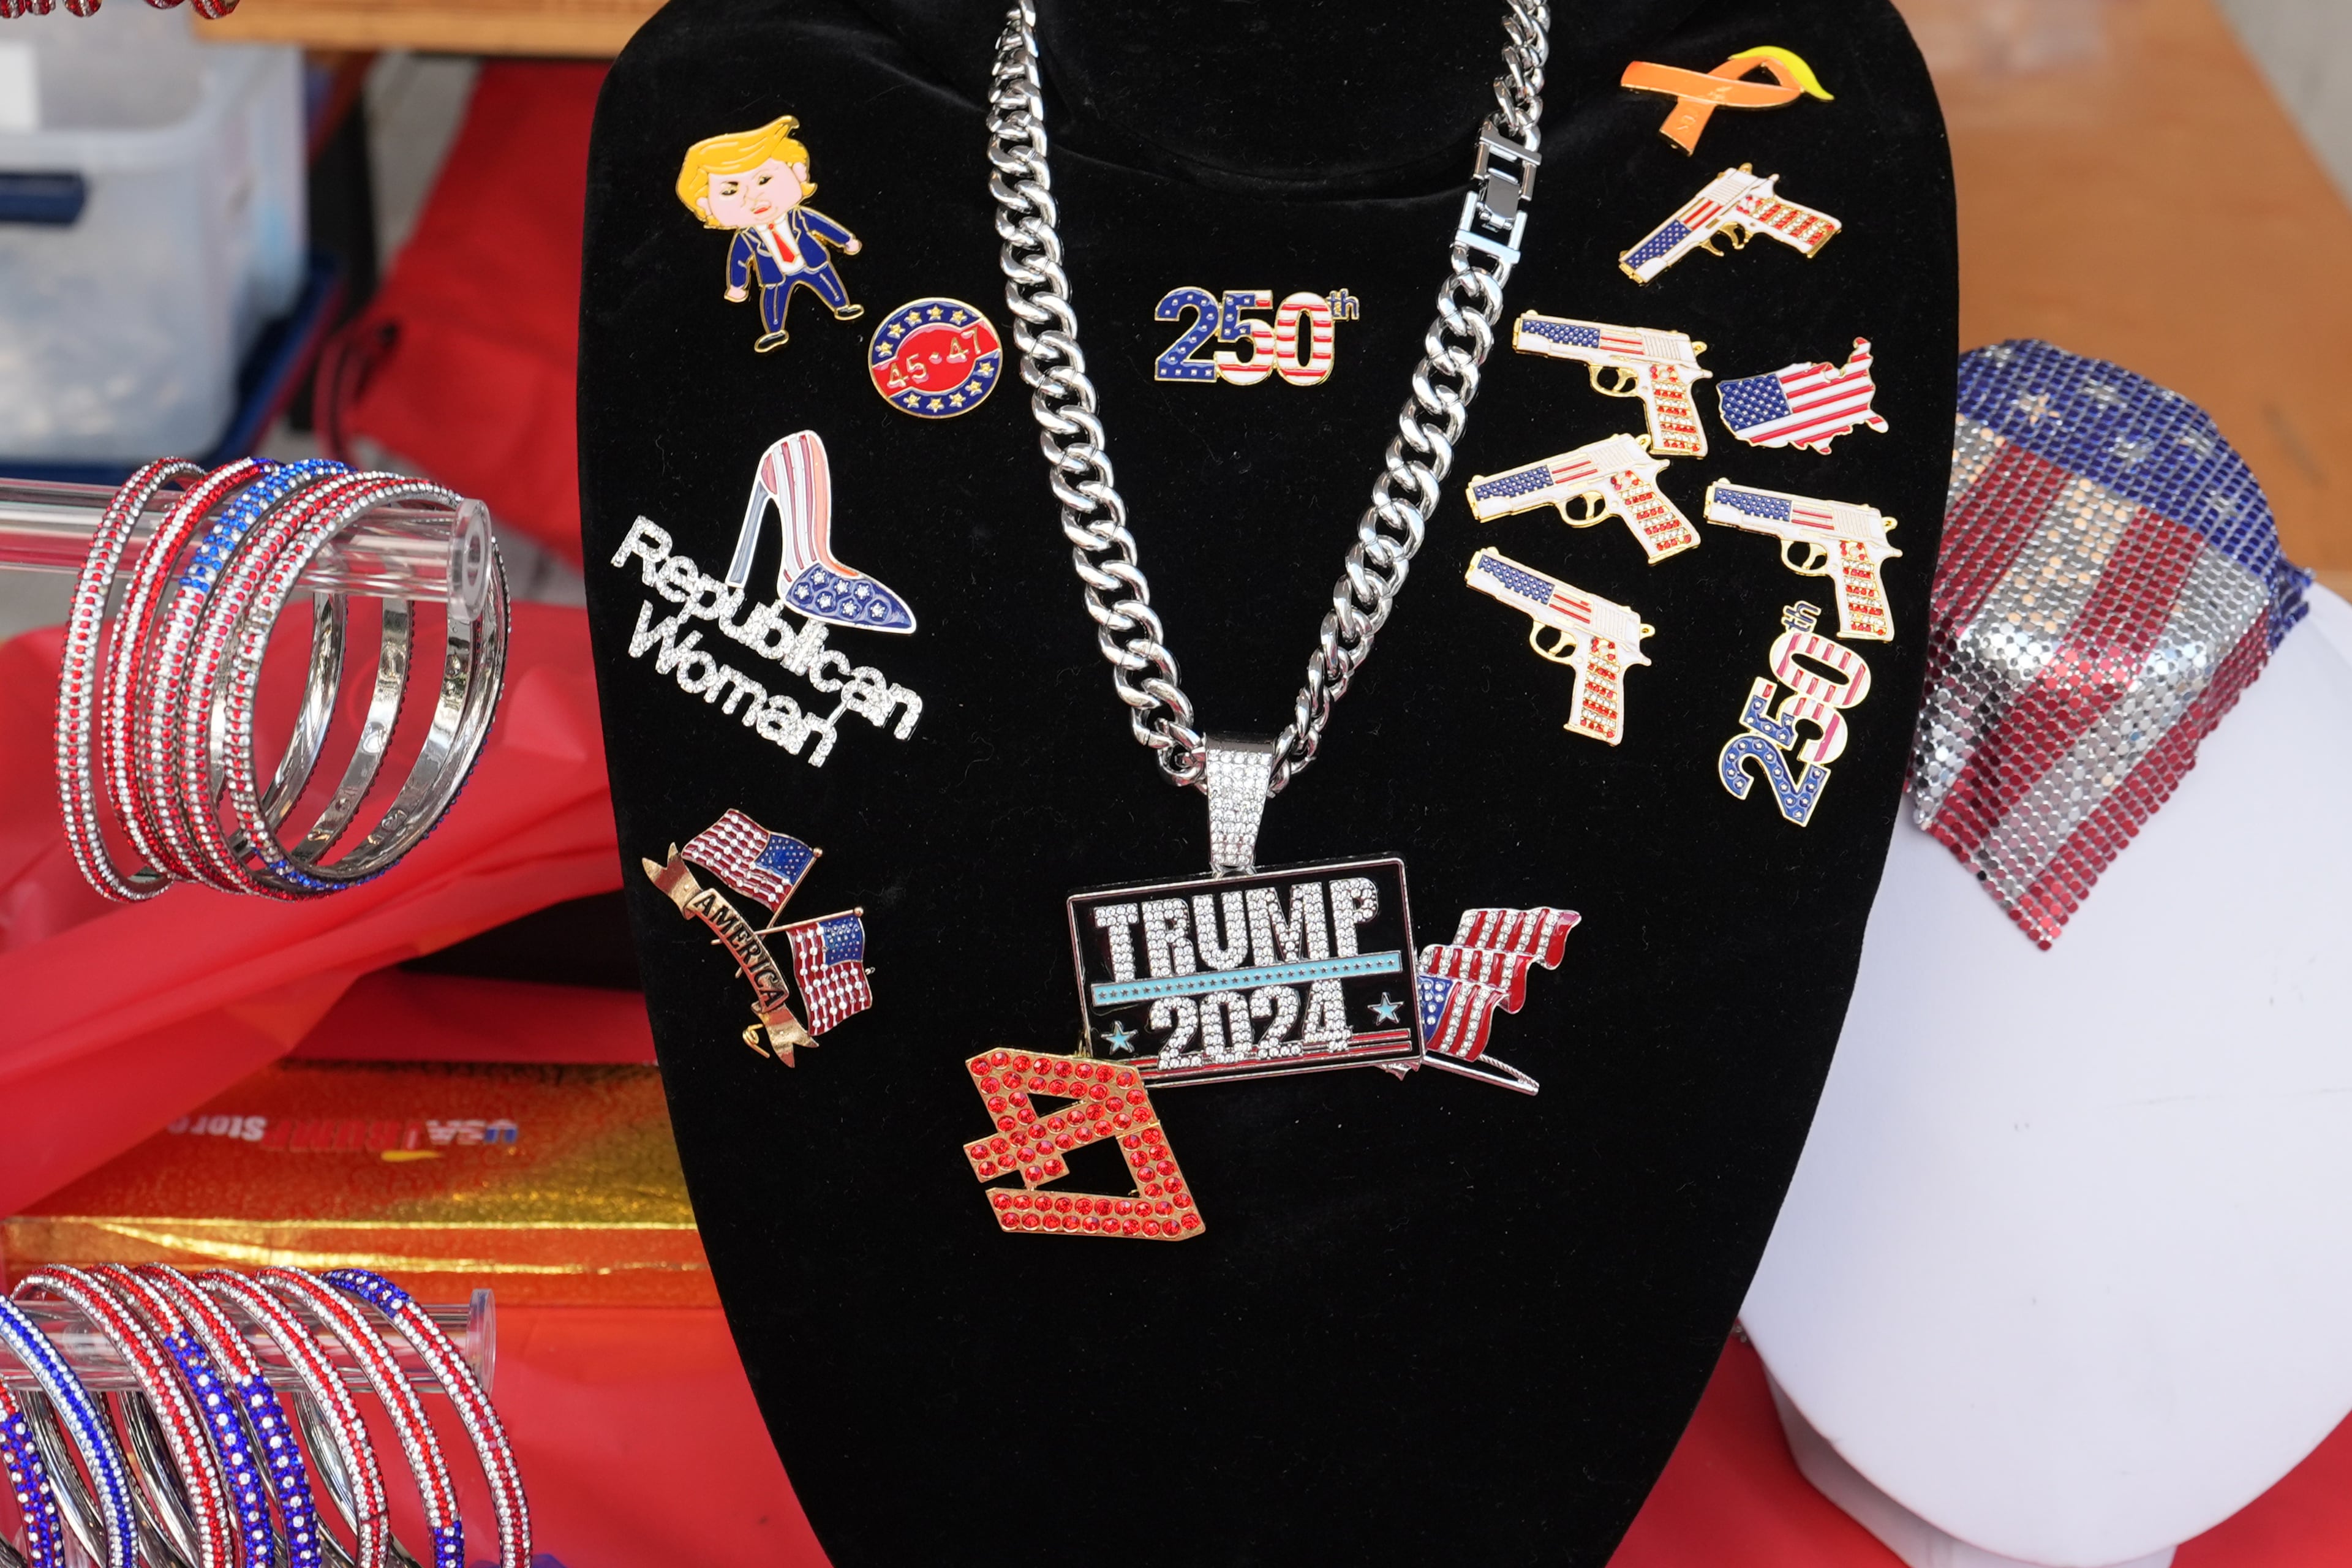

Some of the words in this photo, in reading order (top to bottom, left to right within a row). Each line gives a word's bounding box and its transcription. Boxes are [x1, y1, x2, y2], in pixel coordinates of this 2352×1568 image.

[611, 515, 923, 741] Republican
[628, 600, 837, 767] Woman
[695, 894, 785, 1007] AMERICA
[1093, 877, 1379, 983] TRUMP
[1149, 978, 1352, 1071] 2024
[426, 1119, 519, 1145] USA
